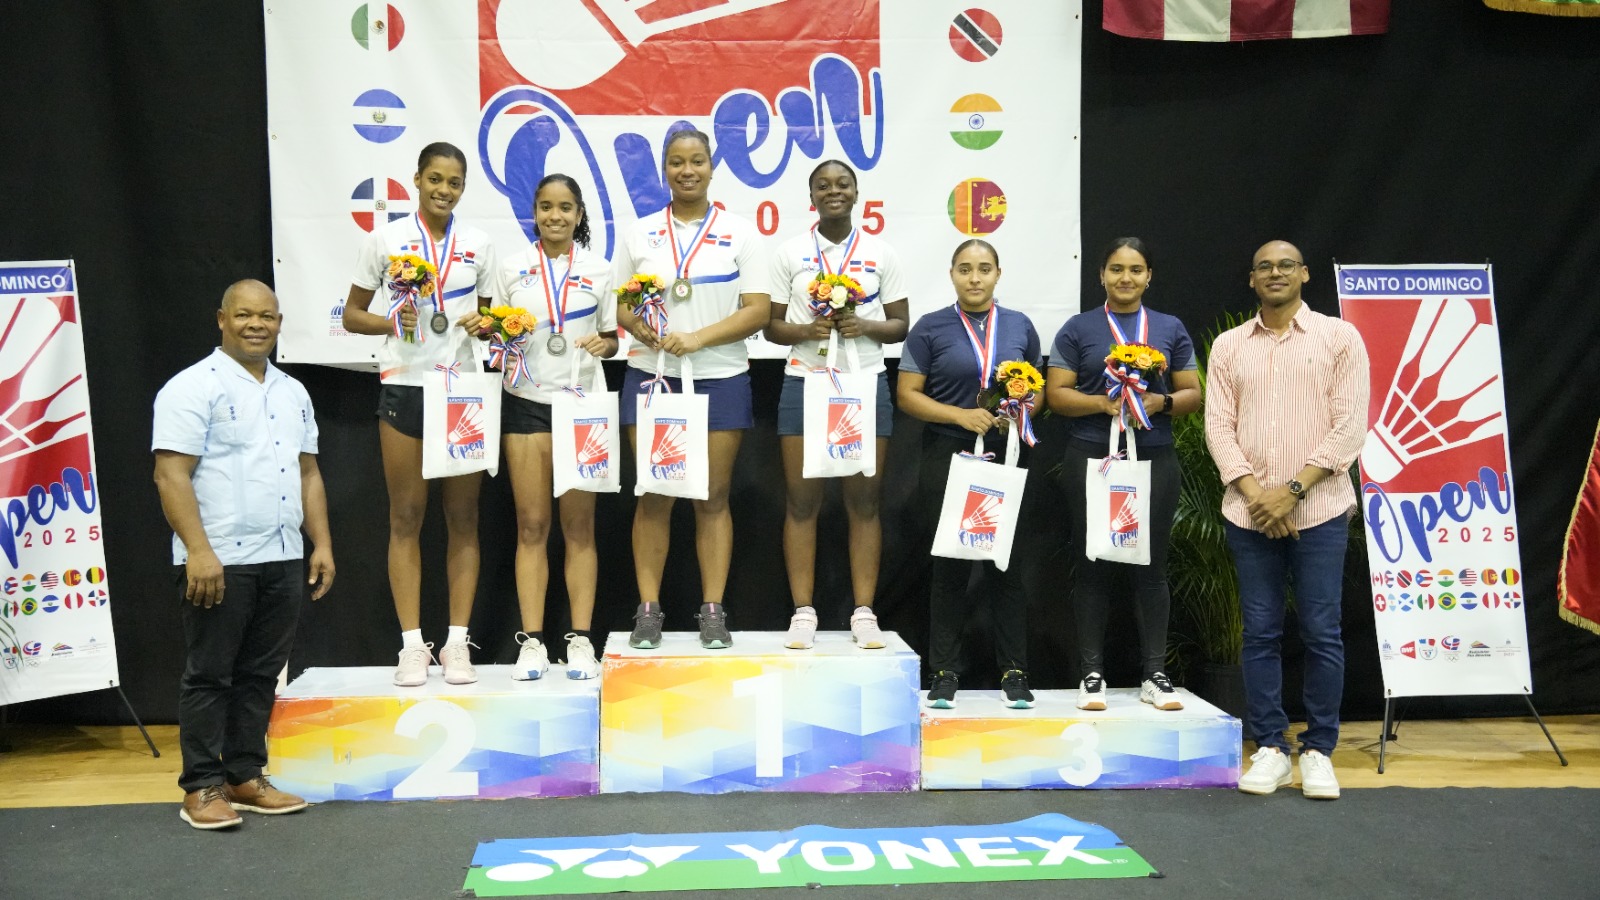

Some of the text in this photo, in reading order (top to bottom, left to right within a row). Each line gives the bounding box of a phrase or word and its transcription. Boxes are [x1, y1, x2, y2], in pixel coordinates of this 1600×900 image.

[711, 200, 886, 237] 05
[0, 274, 67, 290] MINGO
[1344, 276, 1483, 292] SANTO DOMINGO
[446, 439, 485, 460] Open
[826, 439, 862, 460] Open
[577, 459, 608, 479] Open
[650, 460, 686, 480] Open
[1362, 466, 1511, 563] Open
[23, 525, 100, 549] 2025
[958, 528, 995, 548] Open
[1110, 528, 1138, 548] Open
[1437, 526, 1515, 543] 2025
[731, 673, 785, 778] 1
[392, 700, 480, 800] 2
[1057, 723, 1104, 788] 3
[725, 835, 1113, 875] YONEX
